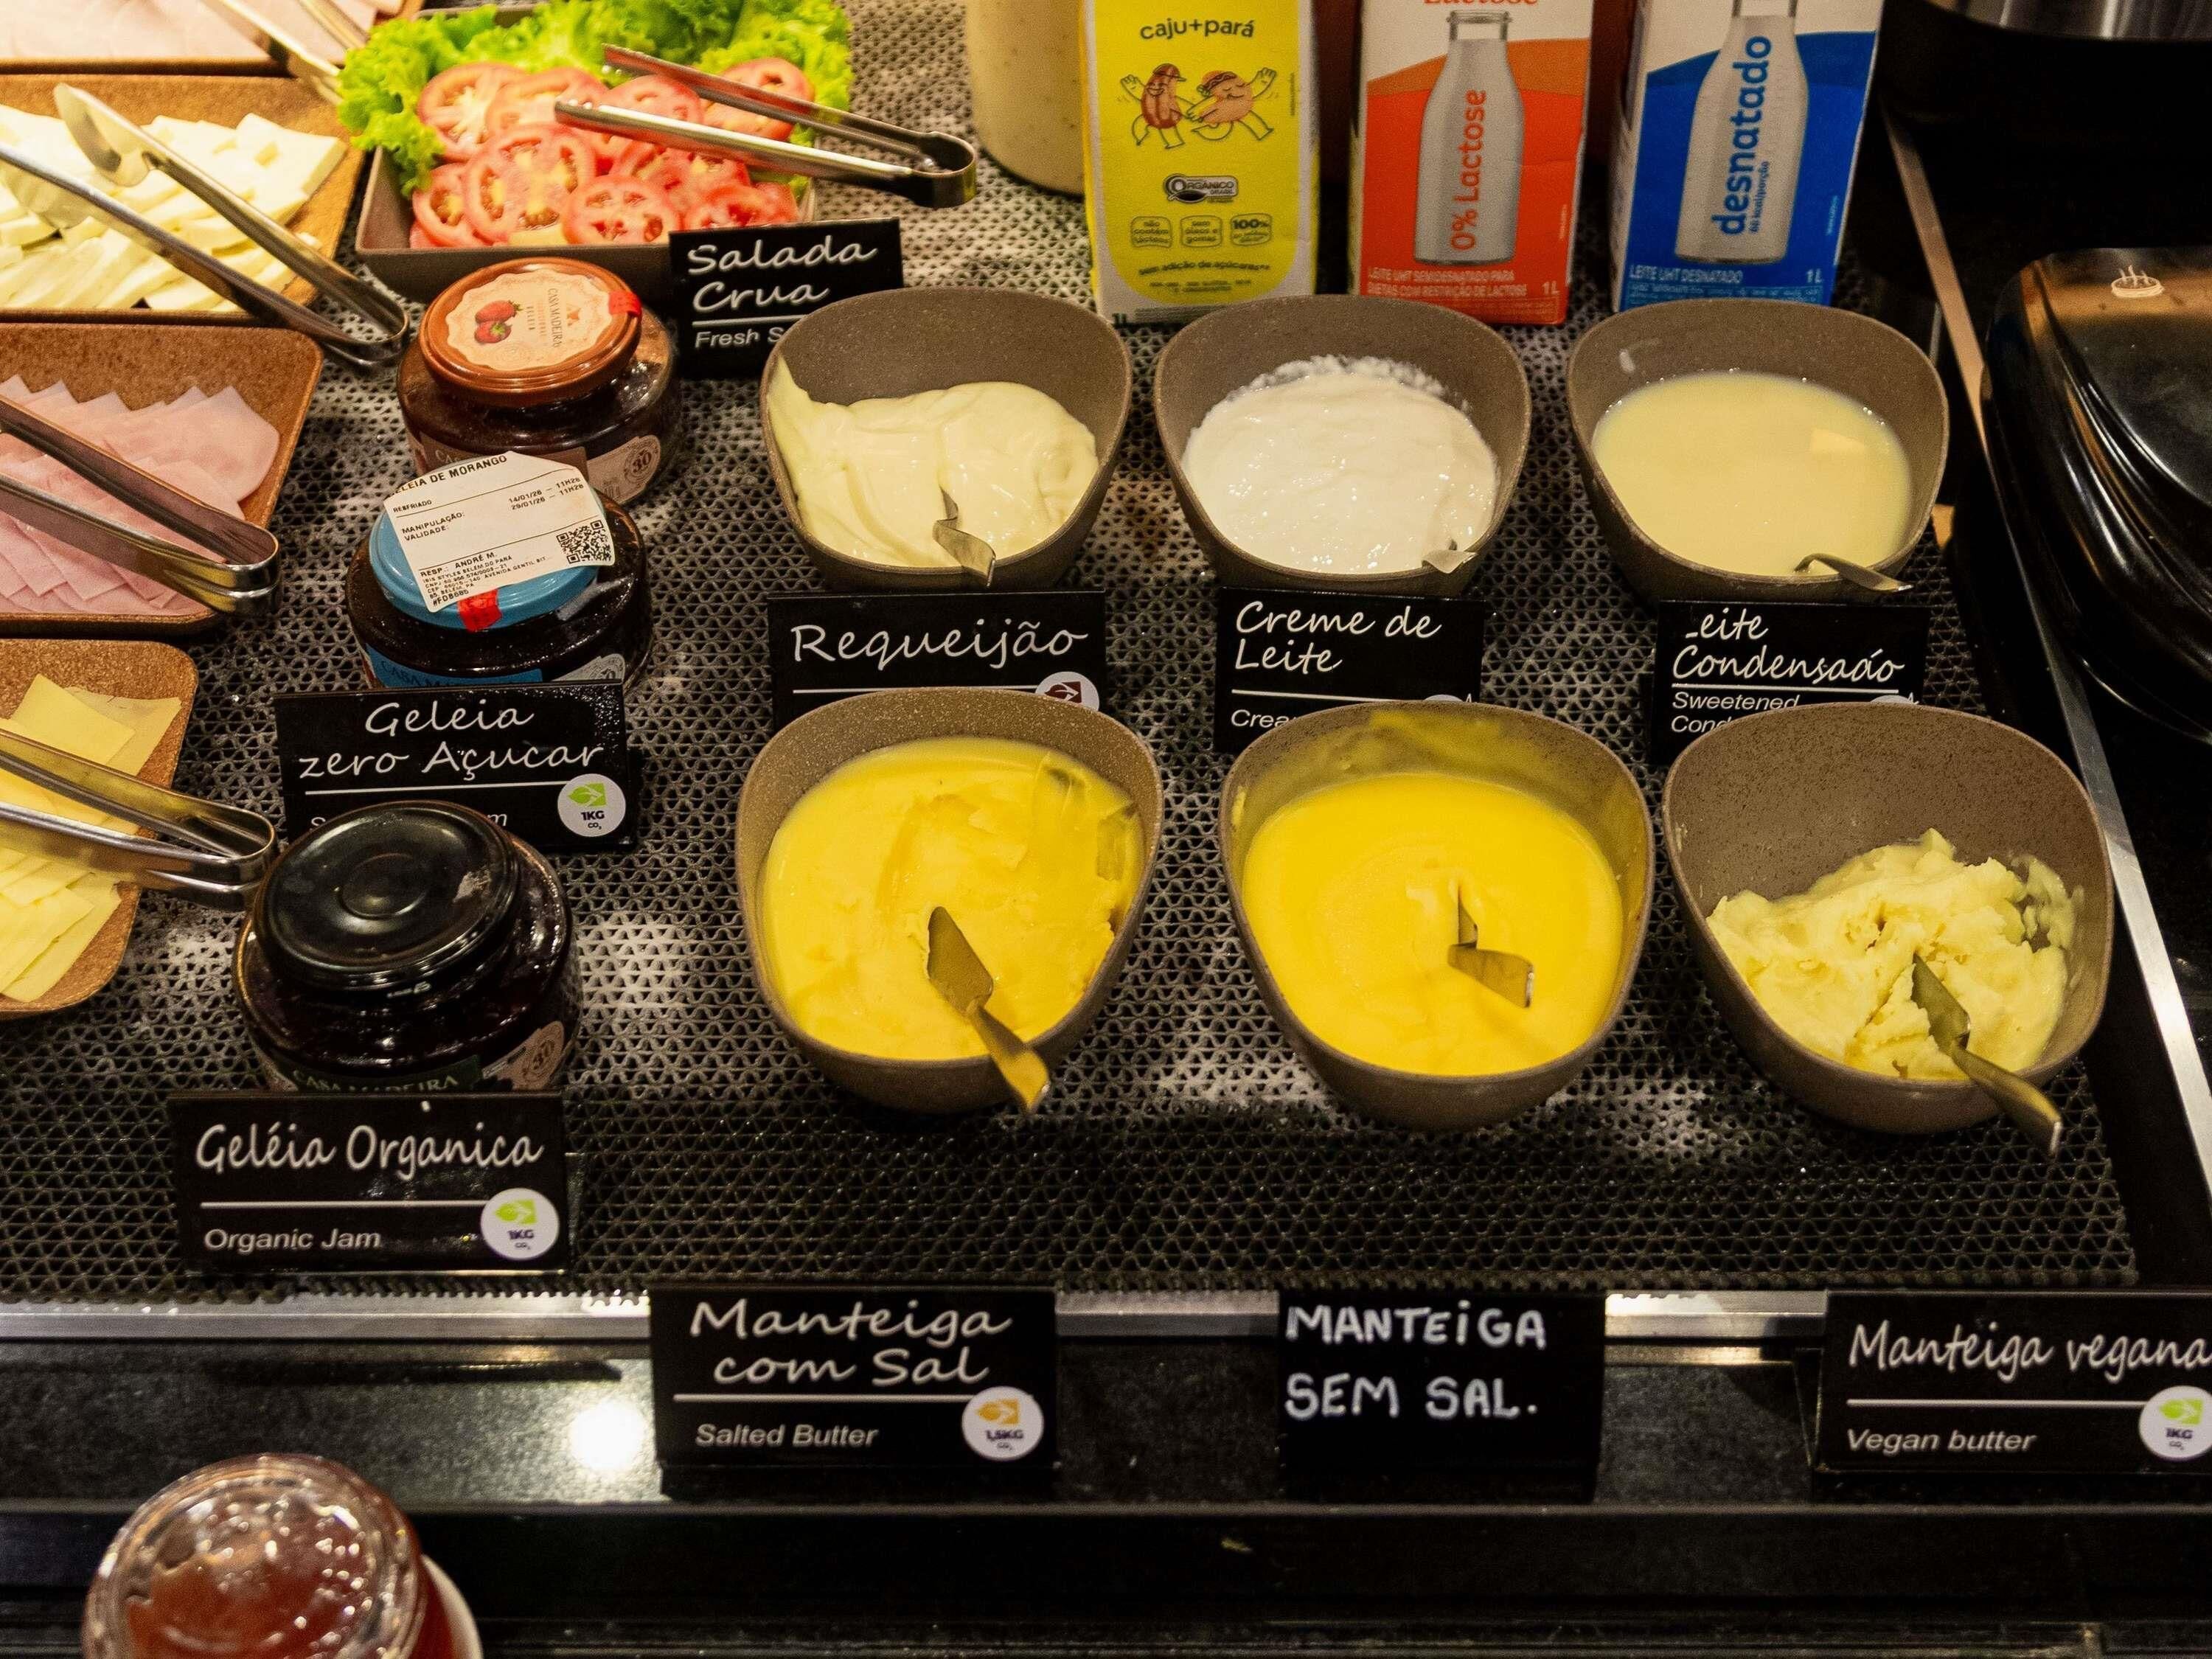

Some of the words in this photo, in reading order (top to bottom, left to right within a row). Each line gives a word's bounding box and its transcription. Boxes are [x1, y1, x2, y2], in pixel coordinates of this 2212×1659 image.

[1139, 18, 1255, 40] caju+pará
[1455, 89, 1487, 202] Lactose
[1711, 35, 1772, 235] desnatado
[1450, 210, 1478, 251] 0%
[687, 234, 877, 275] Salada
[692, 281, 830, 313] Crua
[695, 328, 761, 348] Fresh
[430, 472, 447, 484] DE
[448, 454, 508, 479] MORANGO
[393, 499, 433, 513] RESFRIADO
[401, 512, 465, 534] MANIPULAÇÃO:
[404, 524, 450, 541] VALIDADE:
[455, 553, 484, 568] ANDRÉ
[1236, 600, 1376, 634] Creme
[1385, 605, 1442, 639] de
[790, 618, 1089, 671] Requeijão
[1235, 638, 1343, 675] Leite
[1672, 691, 1801, 711] Sweetened
[364, 699, 535, 737] Geleia
[1231, 709, 1296, 729] Crea
[299, 751, 410, 779] zero
[421, 741, 605, 782] Açucar
[581, 810, 605, 821] 1KG
[195, 1121, 337, 1175] Geléia
[204, 1228, 314, 1256] Organic
[321, 1228, 380, 1250] Jam
[508, 1229, 535, 1240] 1KG
[689, 1298, 1013, 1348] Manteiga
[713, 1356, 857, 1385] com
[871, 1346, 990, 1386] Sal
[1848, 1320, 2053, 1383] Manteiga
[2066, 1333, 2212, 1384] vegana
[1284, 1372, 1400, 1421] SEM
[1425, 1375, 1538, 1421] SAL.
[695, 1422, 786, 1448] Salted
[793, 1422, 880, 1447] Butter
[1848, 1427, 1940, 1456] Vegan
[1948, 1428, 2037, 1452] butter
[2166, 1427, 2194, 1439] 1KG
